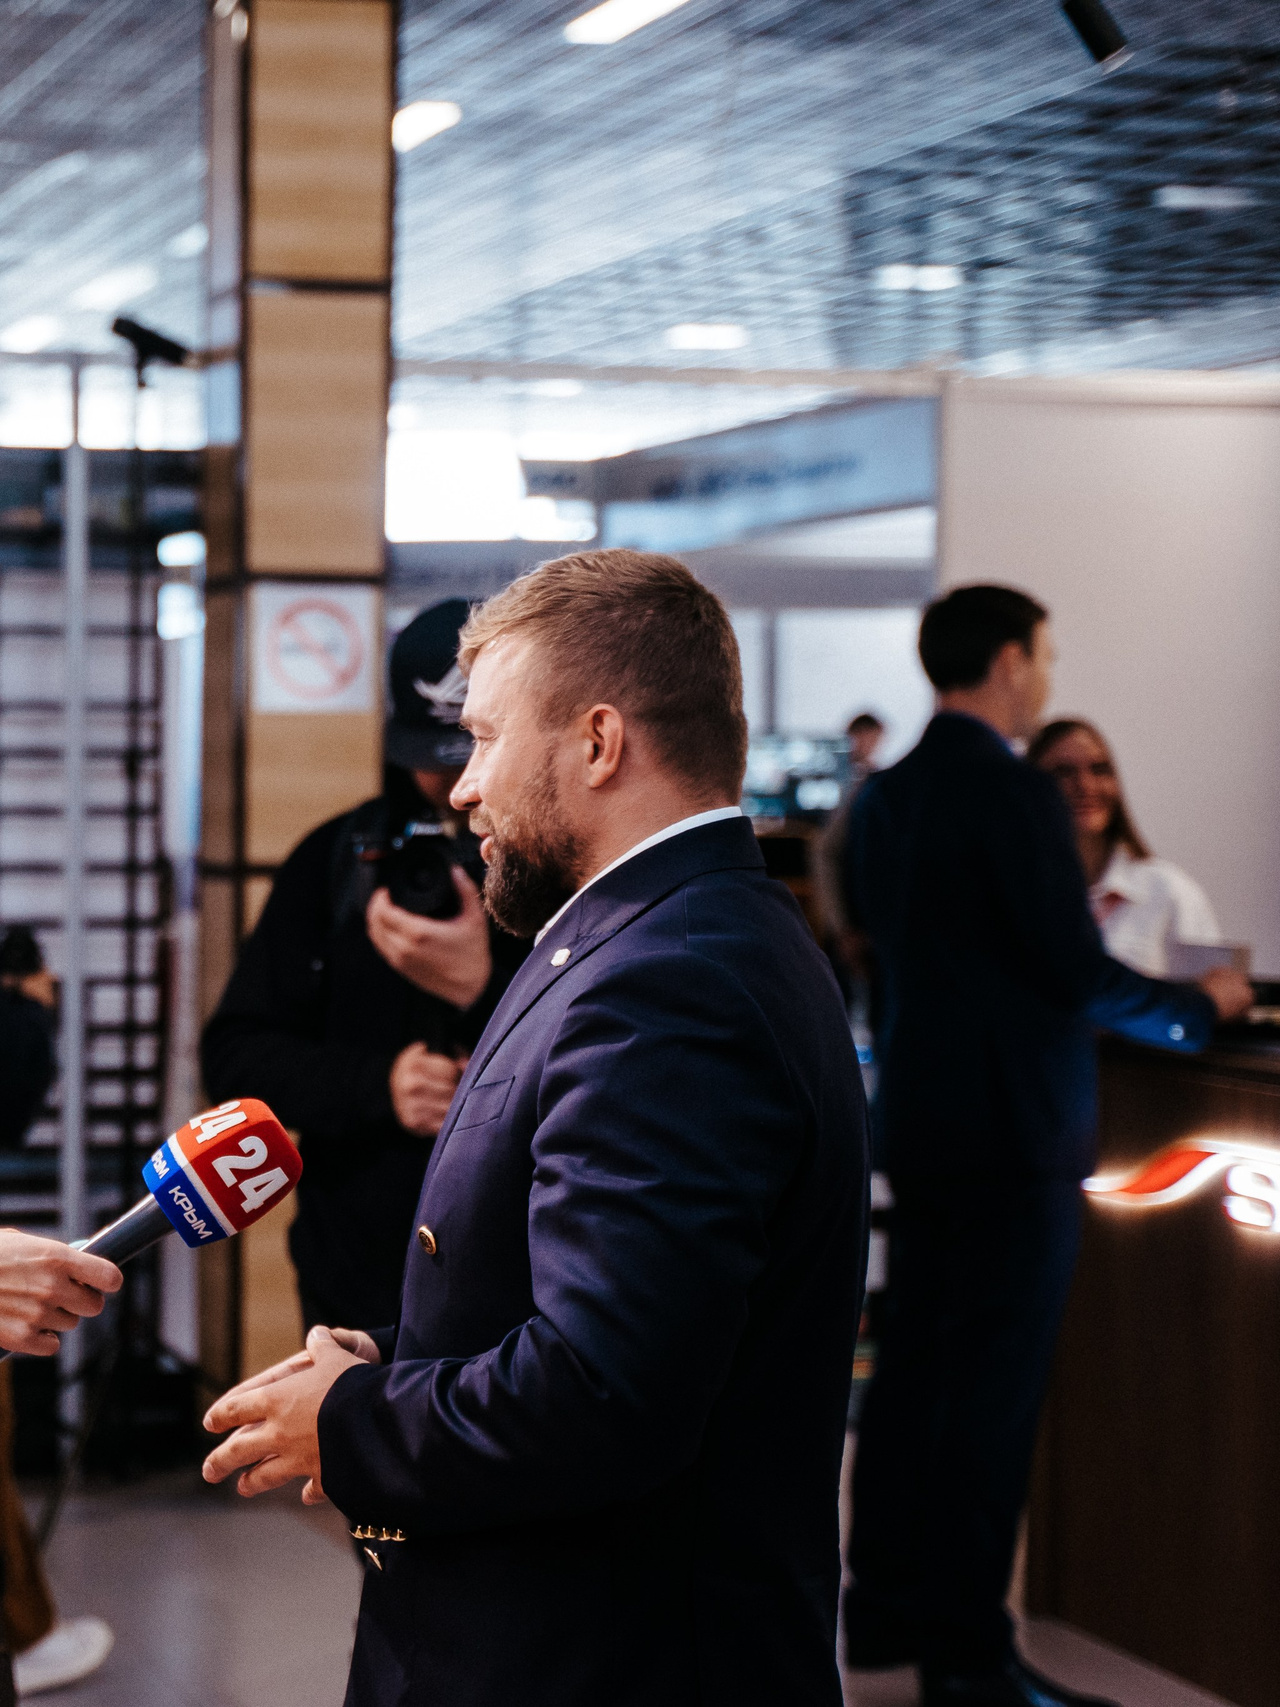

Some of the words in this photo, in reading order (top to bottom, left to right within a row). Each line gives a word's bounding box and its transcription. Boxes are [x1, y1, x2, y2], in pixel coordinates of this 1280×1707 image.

[188, 1100, 248, 1144] 24
[211, 1135, 290, 1214] 24
[168, 1185, 213, 1239] КРЫМ
